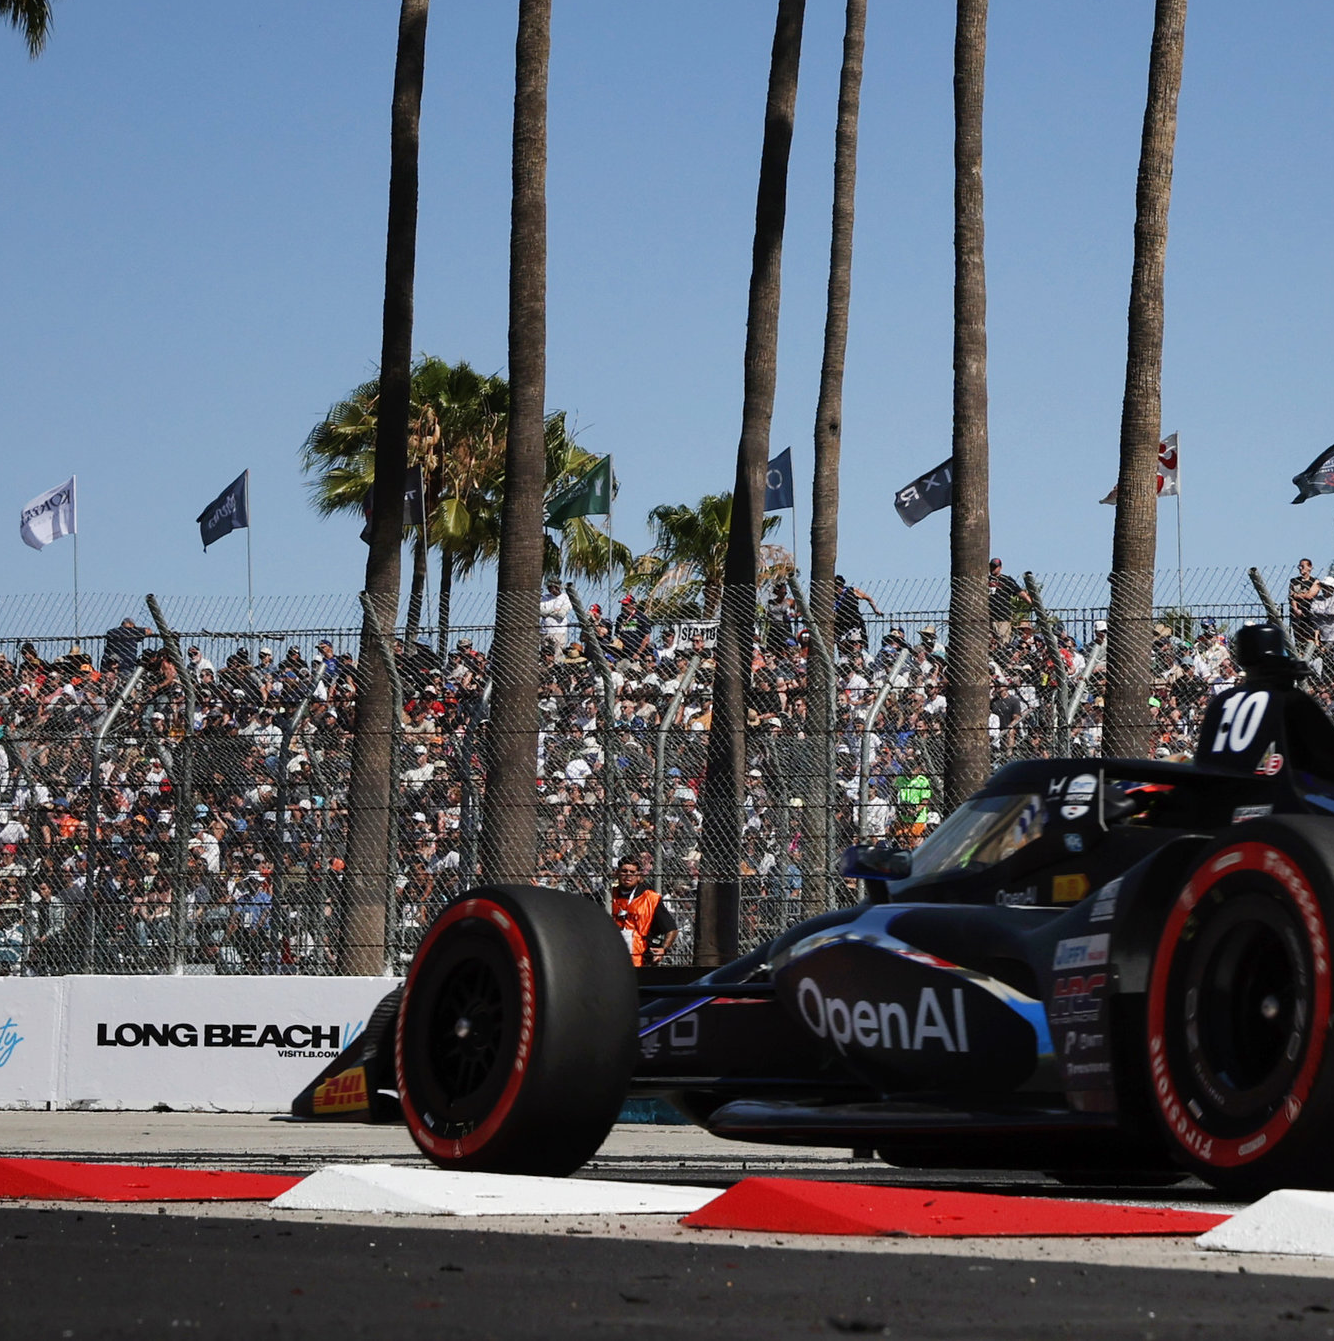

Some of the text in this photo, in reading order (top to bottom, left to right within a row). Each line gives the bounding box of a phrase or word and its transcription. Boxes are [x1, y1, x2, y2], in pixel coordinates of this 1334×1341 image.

[681, 626, 717, 641] SECTIO
[1212, 691, 1269, 752] 10
[797, 977, 969, 1056] OpenAI
[97, 1023, 198, 1048] LONG
[204, 1024, 340, 1049] BEACH
[277, 1049, 340, 1059] VISITLB.COM
